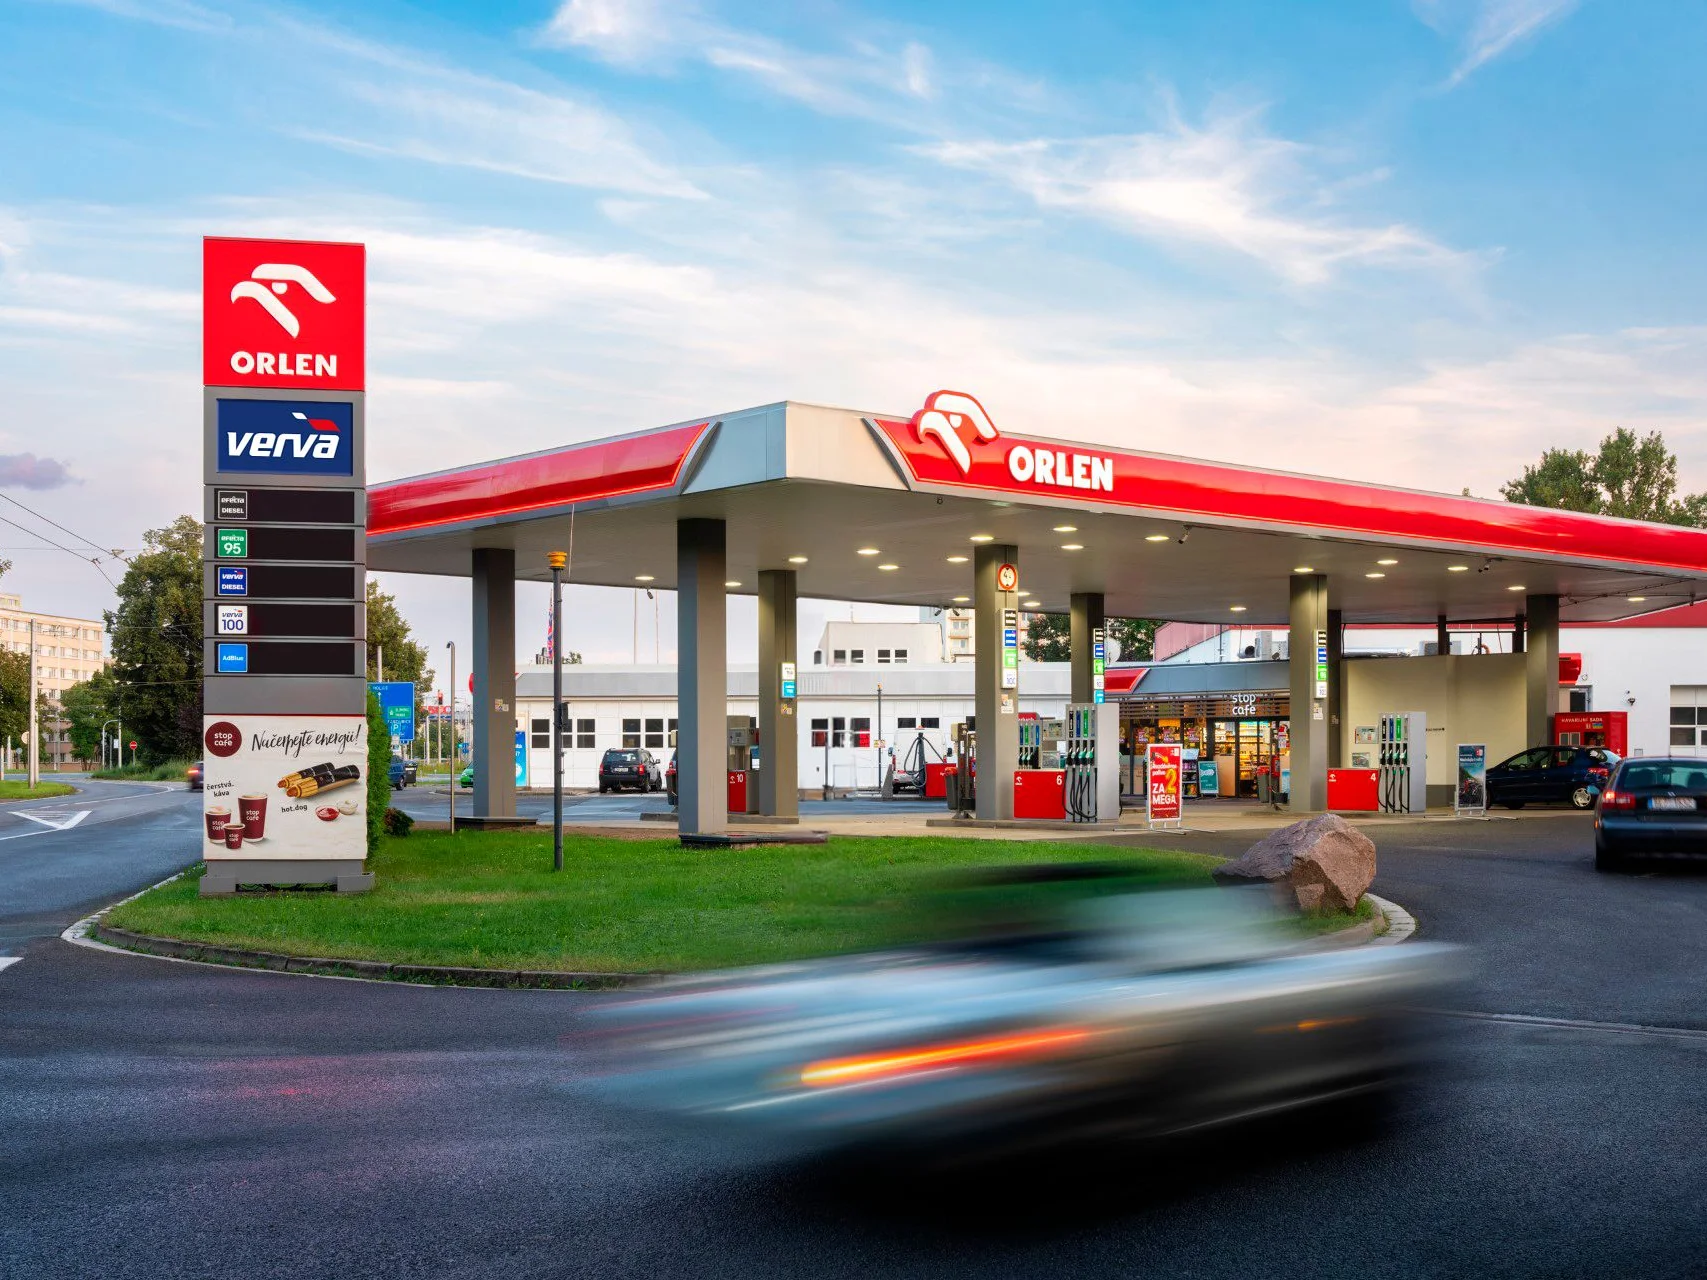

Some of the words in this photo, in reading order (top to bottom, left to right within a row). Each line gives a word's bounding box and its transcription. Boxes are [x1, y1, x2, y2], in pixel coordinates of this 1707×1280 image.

[230, 350, 337, 377] ORLEN
[227, 431, 340, 459] verva
[1008, 445, 1113, 492] ORLEN
[223, 542, 242, 555] 95
[221, 619, 244, 631] 100
[1232, 693, 1256, 705] stop
[1232, 704, 1256, 716] cafe
[214, 731, 233, 740] stop
[214, 739, 233, 747] cafe
[736, 773, 744, 783] 10
[1056, 775, 1063, 786] 6
[1152, 783, 1165, 794] ZA
[1165, 768, 1177, 794] 2
[1370, 773, 1377, 782] 4
[1152, 793, 1176, 805] MEGA
[246, 809, 260, 817] stop
[294, 804, 308, 812] dog
